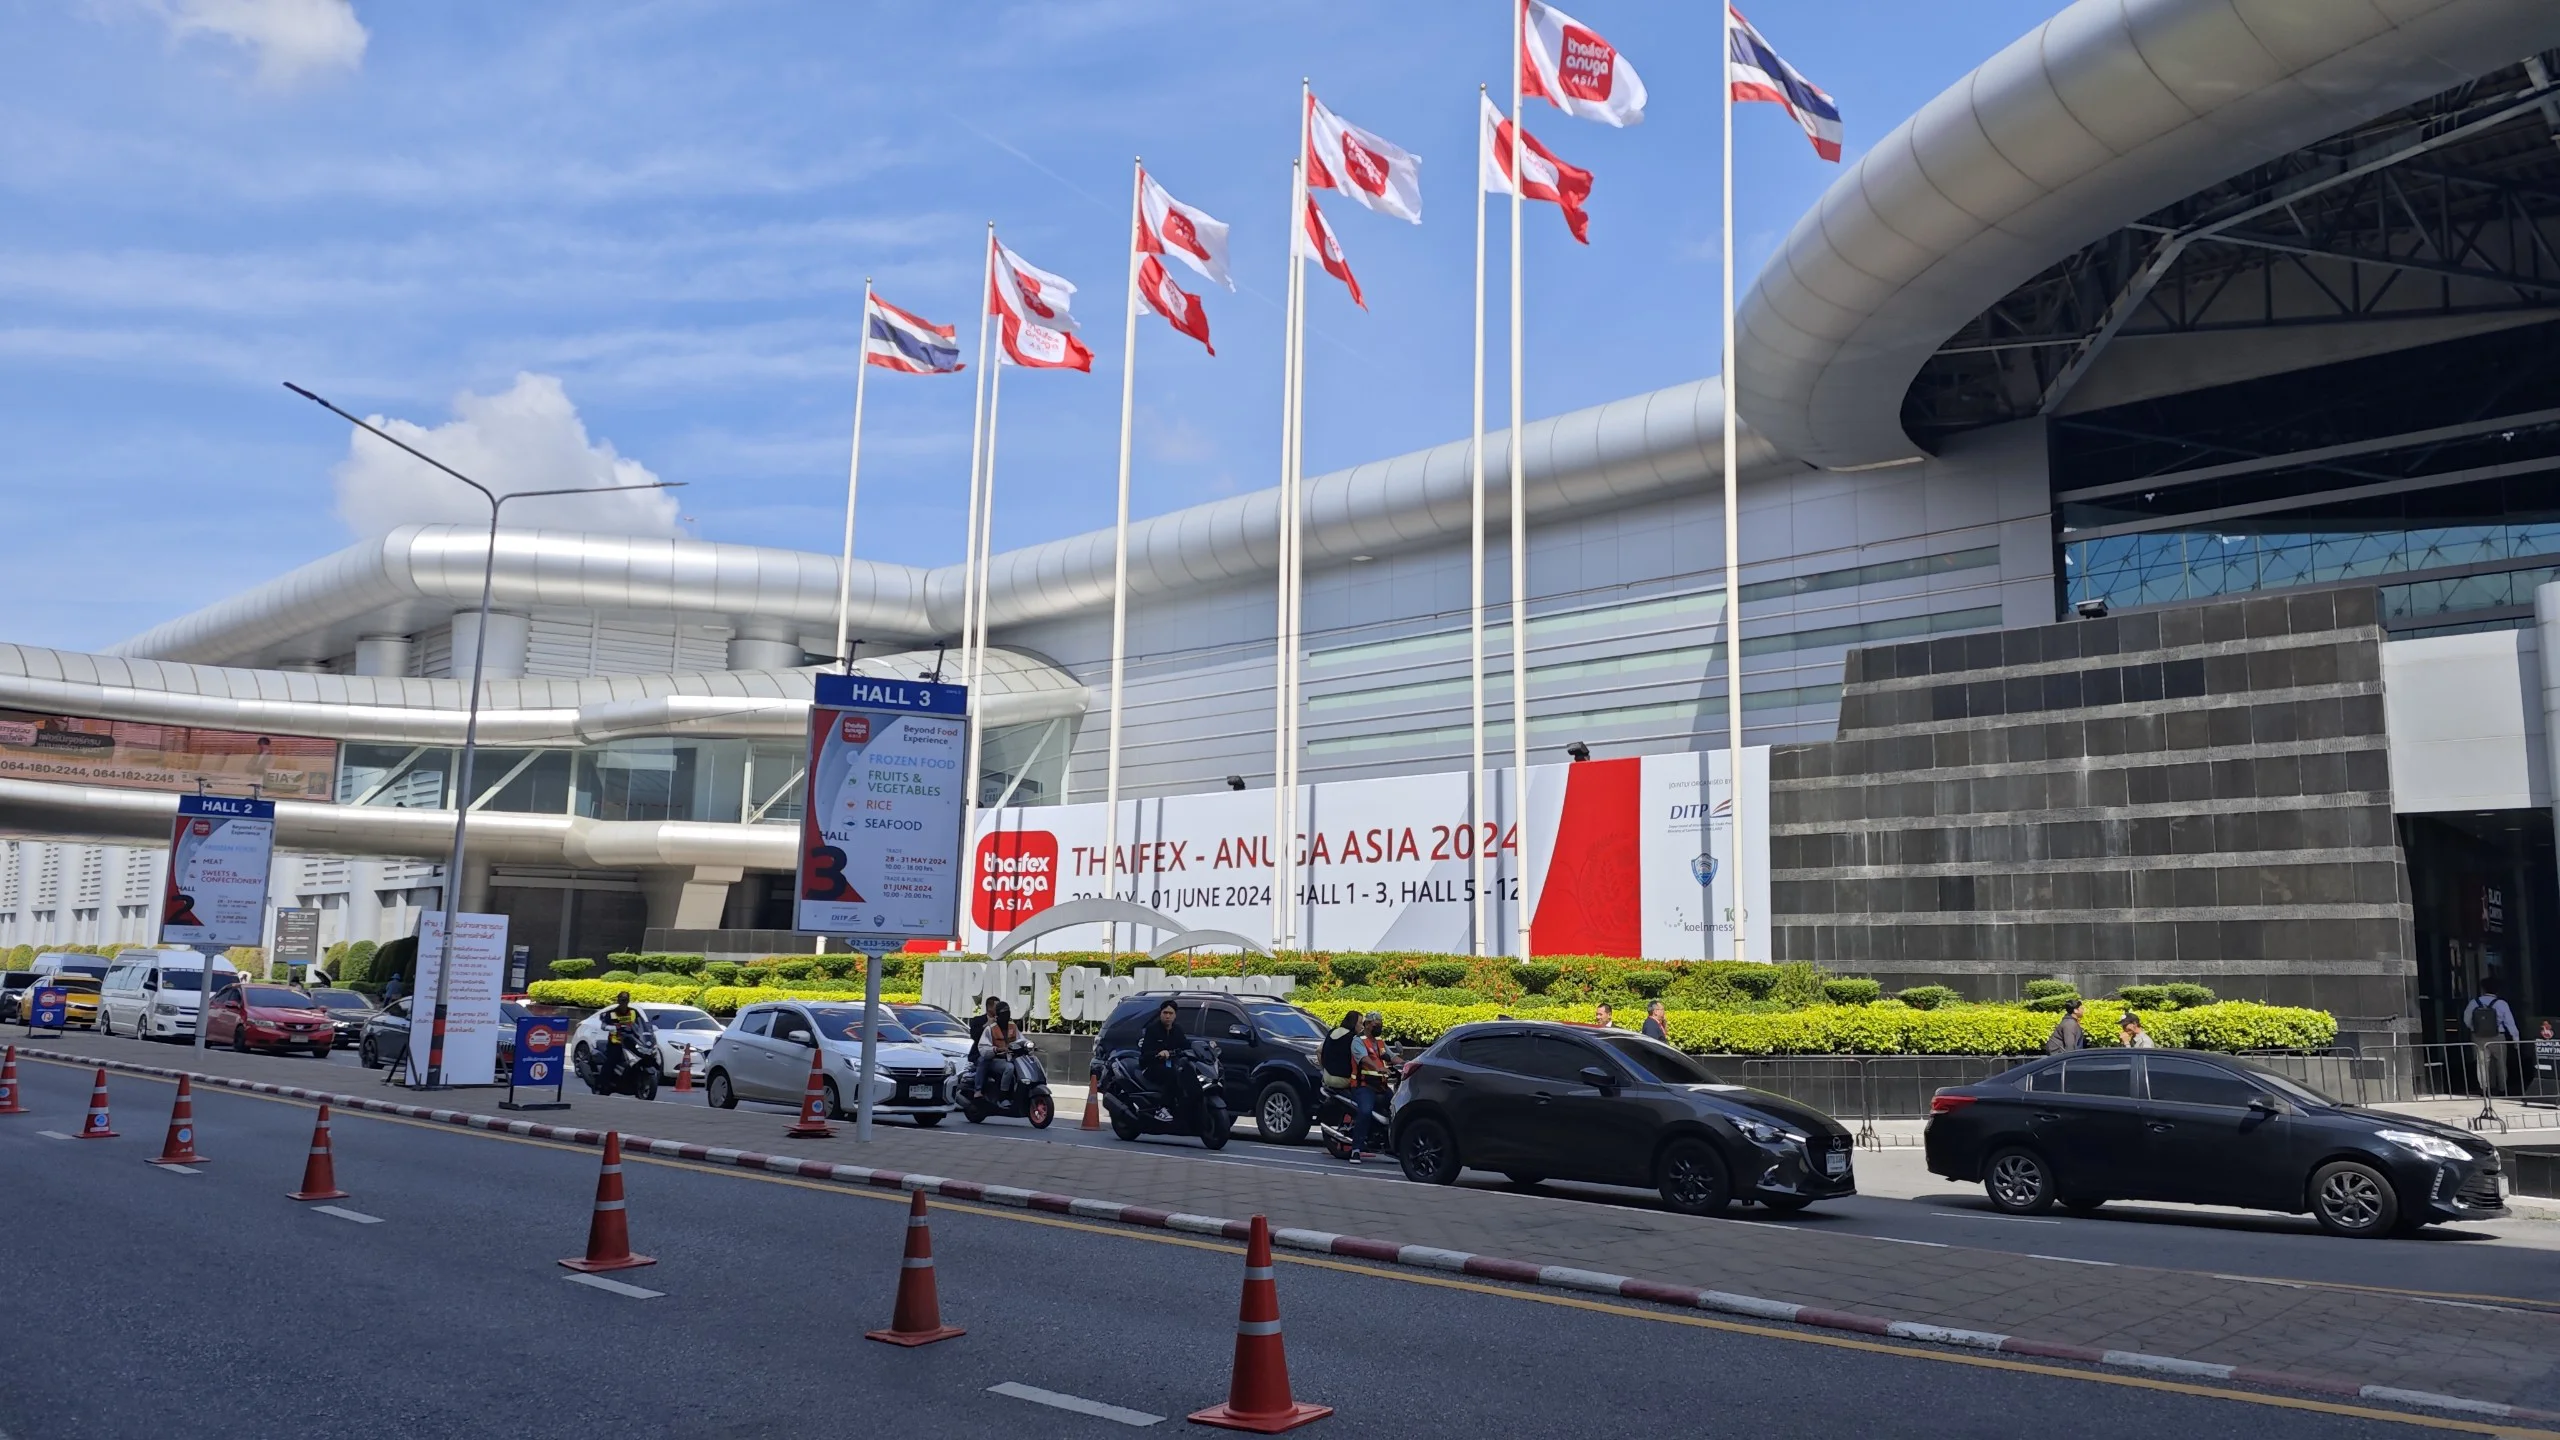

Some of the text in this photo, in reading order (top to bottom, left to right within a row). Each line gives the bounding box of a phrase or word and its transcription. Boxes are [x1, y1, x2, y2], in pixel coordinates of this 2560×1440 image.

[1566, 55, 1609, 77] anuga
[1571, 74, 1599, 88] ASIA
[852, 684, 931, 707] HALL 3
[904, 725, 958, 737] Beyond Food
[903, 735, 949, 745] Experience
[869, 754, 956, 769] FROZEN FOOD
[0, 760, 90, 778] 064-180-2244,
[92, 768, 175, 783] 064-182-2245
[868, 770, 922, 783] FRUITS &
[868, 782, 941, 797] VEGETABLES
[1668, 781, 1690, 790] JOINTLY
[1691, 779, 1724, 787] ORGANISED
[202, 801, 253, 814] HALL 2
[866, 800, 892, 810] RICE
[1670, 803, 1709, 819] DITP
[865, 818, 923, 831] SEAFOOD
[819, 831, 850, 841] HALL
[1072, 840, 1188, 876] THAIFEX
[1340, 827, 1420, 864] ASIA
[1430, 822, 1518, 861] 2024
[983, 851, 1050, 873] thaifex
[806, 845, 848, 900] 3
[200, 876, 263, 885] CONFECTIONERY
[982, 875, 1048, 897] anuga
[1151, 889, 1170, 909] 01
[1174, 887, 1220, 913] JUNE
[1226, 885, 1272, 907] 2024
[1346, 882, 1355, 904] 1
[1375, 882, 1393, 907] 3,
[1401, 880, 1457, 903] HALL
[1464, 879, 1475, 902] 5
[1497, 877, 1519, 901] 12
[168, 894, 195, 925] 2
[993, 897, 1034, 911] ASIA
[1684, 922, 1735, 931] koelnmess
[922, 960, 1059, 1019] IMPACT
